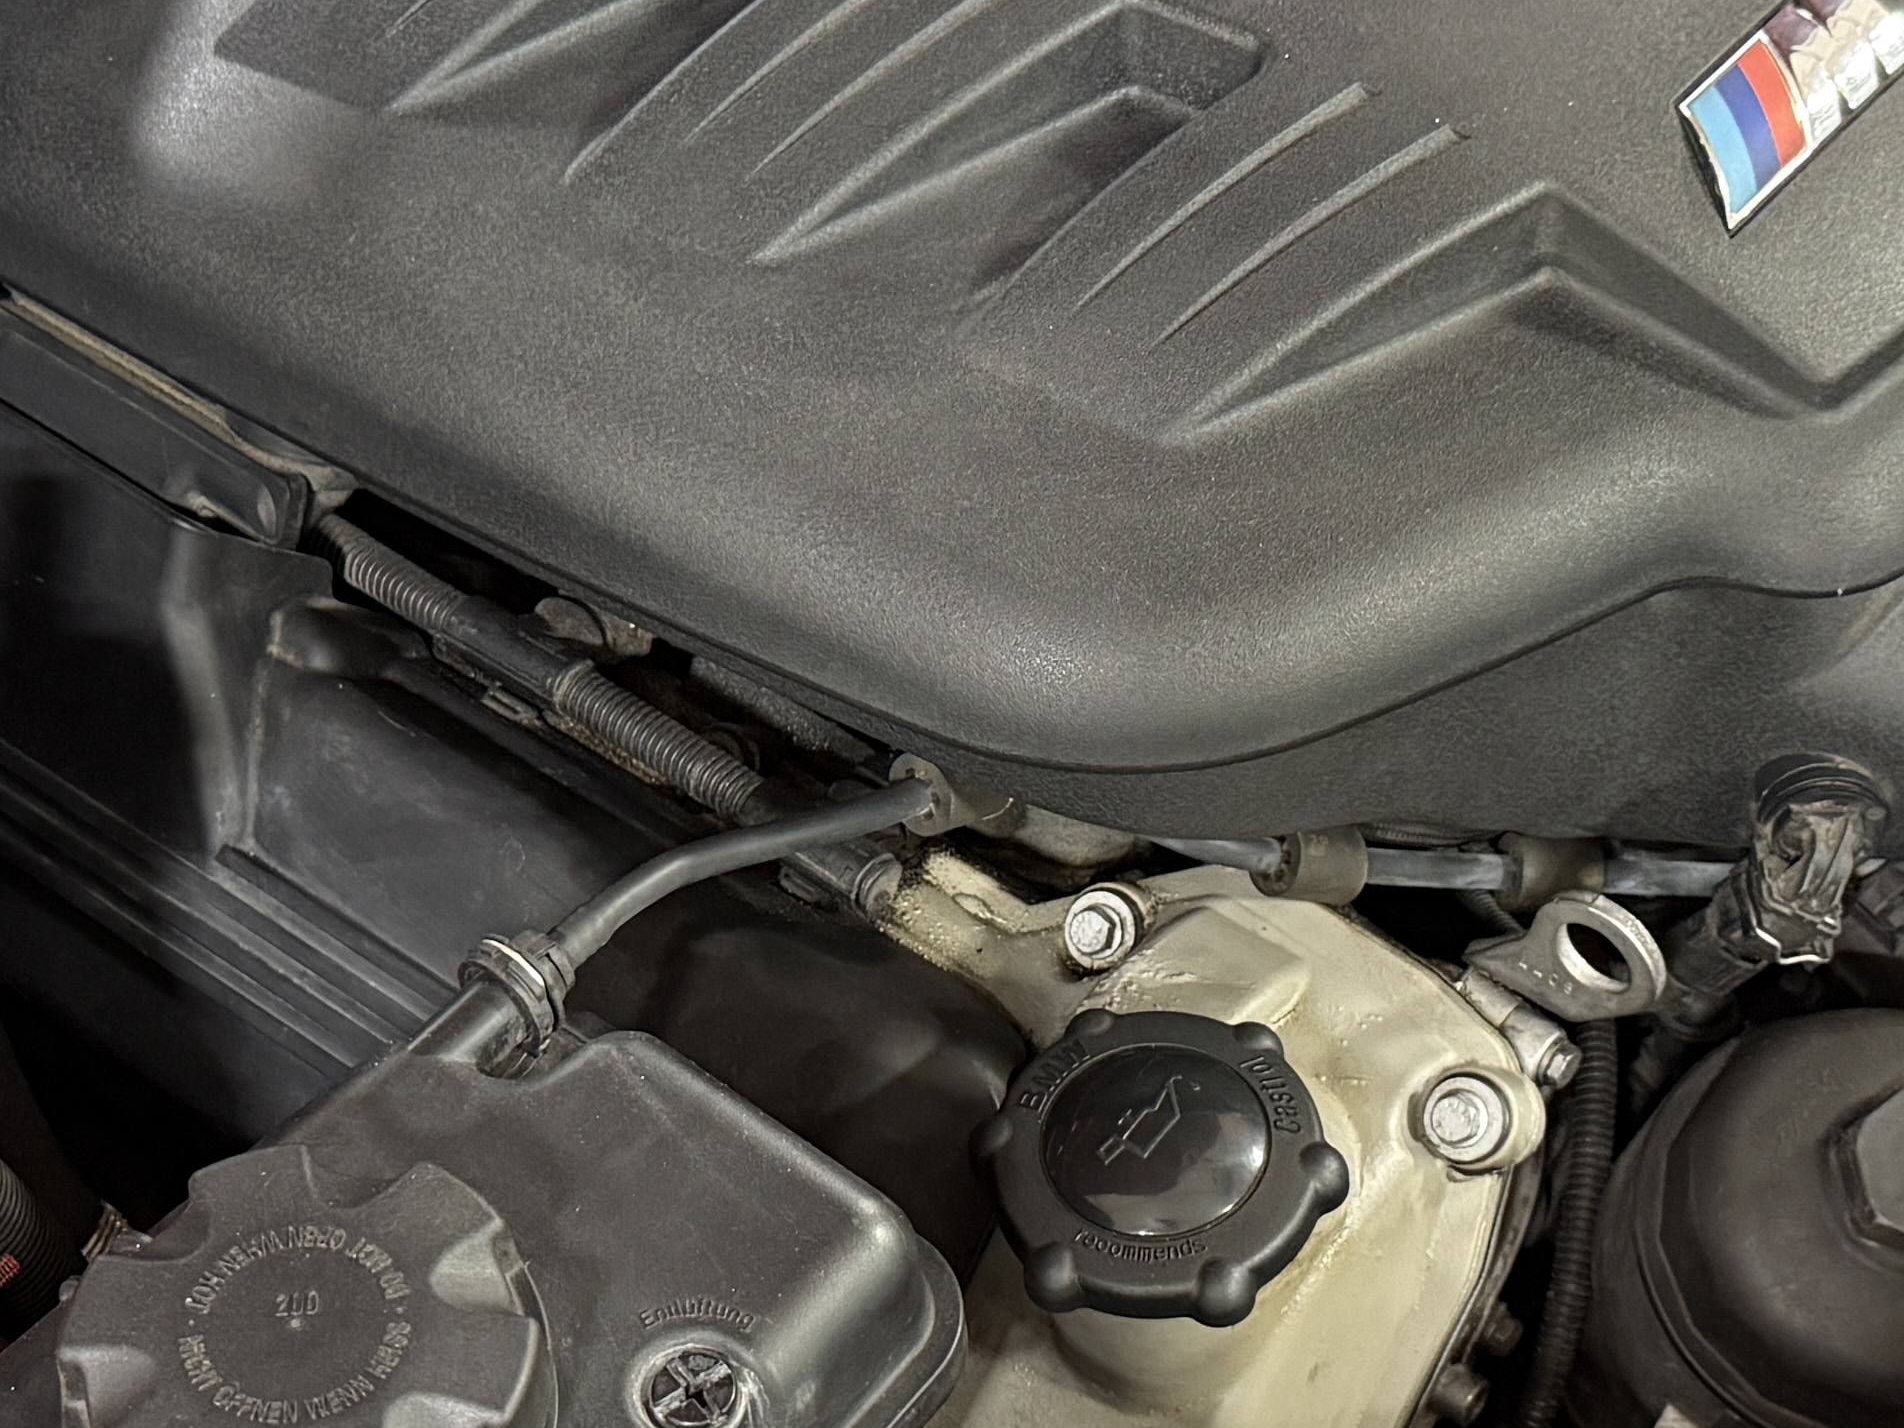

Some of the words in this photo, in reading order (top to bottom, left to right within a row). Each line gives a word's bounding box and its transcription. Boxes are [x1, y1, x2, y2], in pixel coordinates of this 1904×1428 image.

[1019, 1039, 1092, 1123] BMW
[1074, 1227, 1208, 1264] recommends
[1239, 1055, 1302, 1135] Castrol
[218, 1229, 285, 1277] WHEN
[288, 1225, 347, 1251] OPEN
[346, 1237, 393, 1273] NOT
[185, 1270, 225, 1314] HOT
[379, 1270, 410, 1299] DO
[178, 1334, 223, 1392] NICHT
[303, 1374, 375, 1421] WENN
